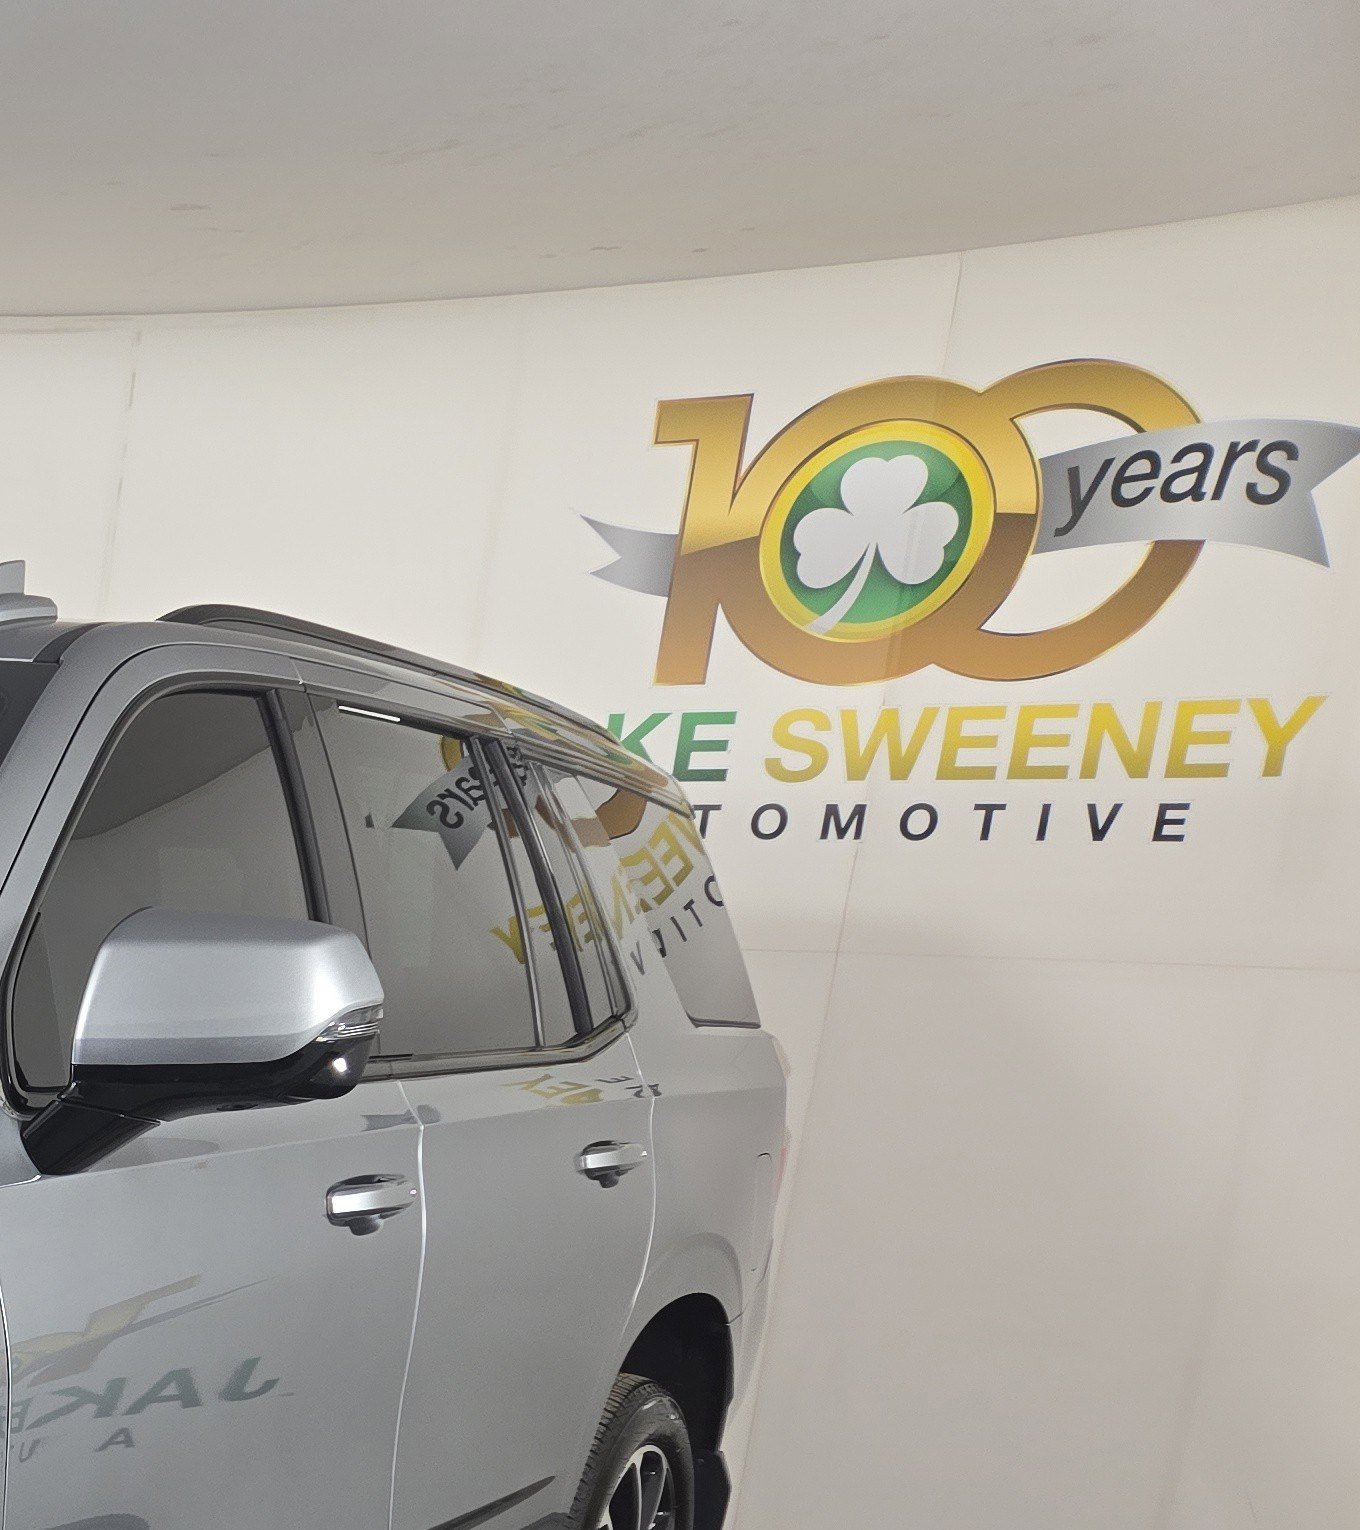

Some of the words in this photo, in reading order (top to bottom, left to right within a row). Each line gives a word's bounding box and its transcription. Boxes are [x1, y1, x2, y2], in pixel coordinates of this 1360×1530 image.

[651, 357, 1206, 688] 100
[1053, 437, 1300, 536] years
[607, 711, 738, 782] KE
[763, 695, 1328, 783] SWEENEY
[693, 802, 1192, 842] TOMOTIVE
